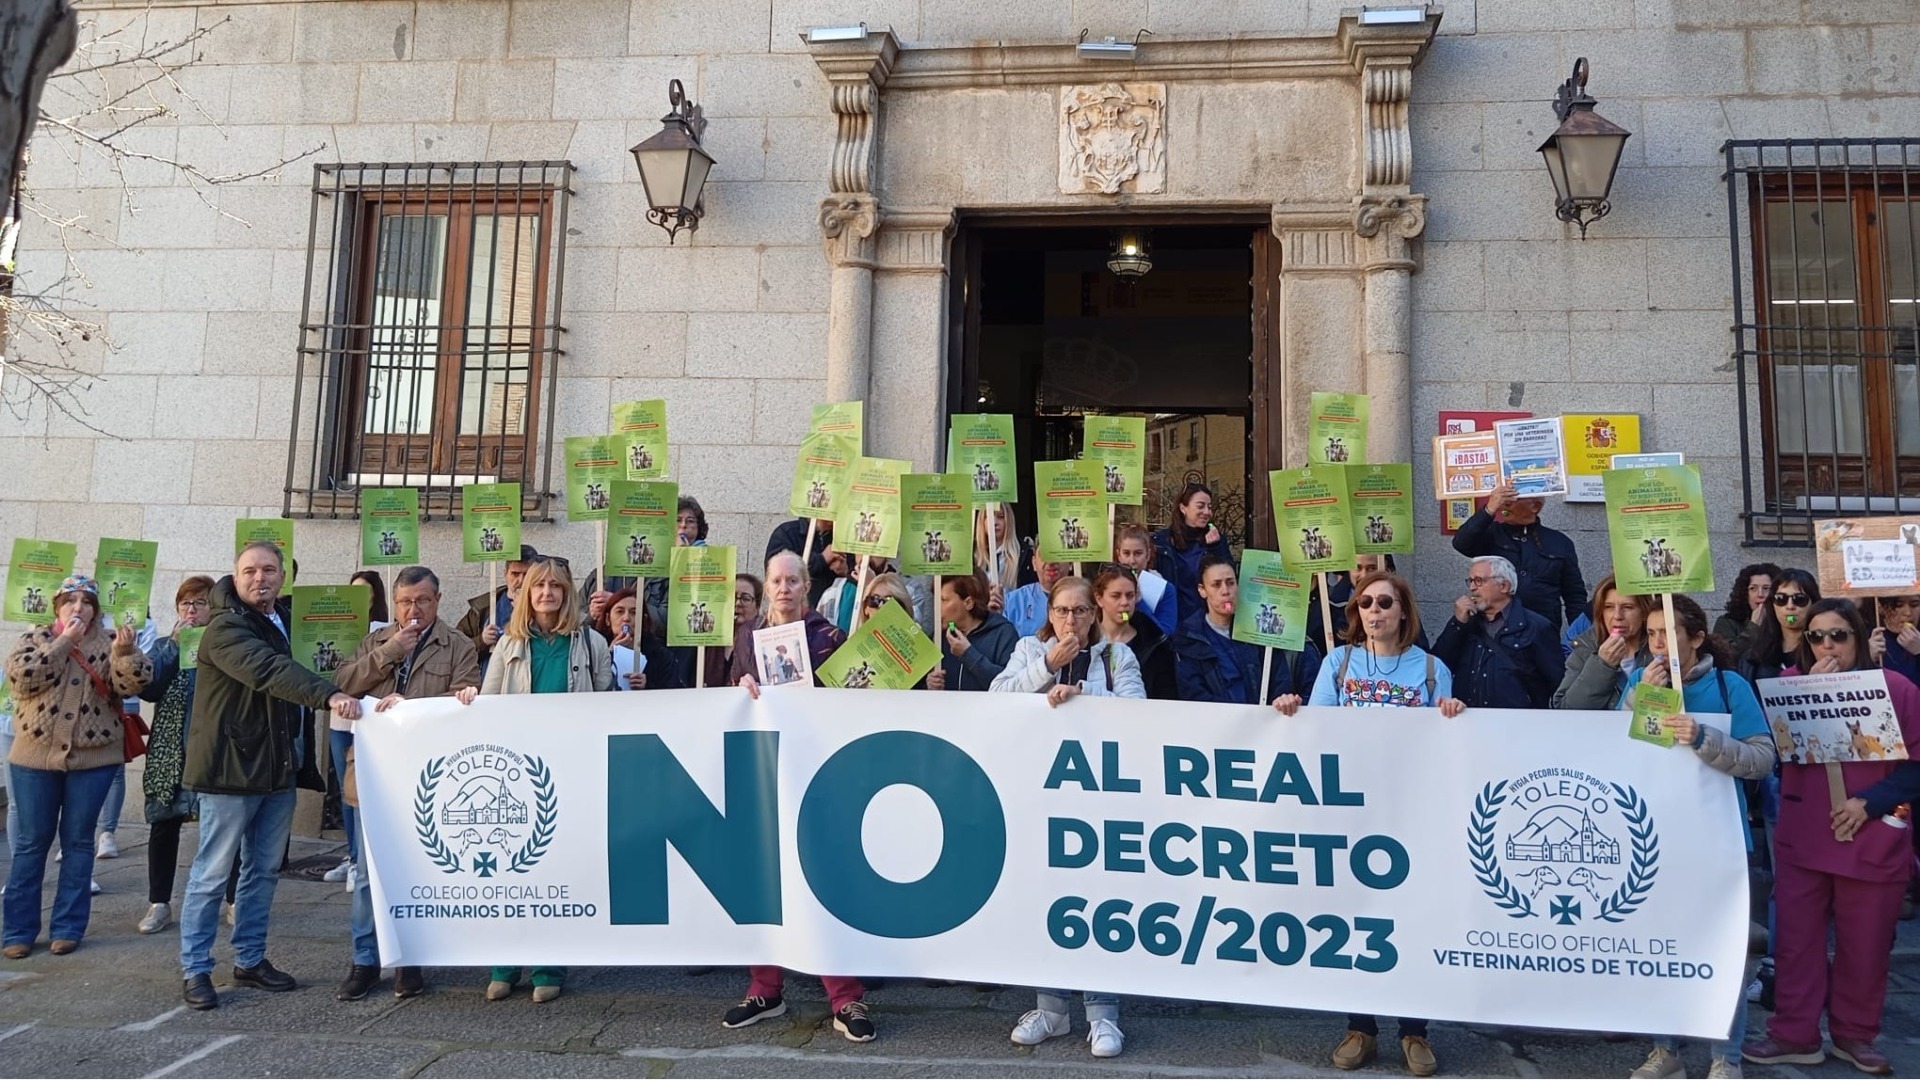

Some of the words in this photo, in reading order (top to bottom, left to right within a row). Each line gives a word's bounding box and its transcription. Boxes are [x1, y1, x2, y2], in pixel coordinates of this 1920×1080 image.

[1454, 452, 1489, 465] ¡BASTA!
[1764, 693, 1834, 708] NUESTRA
[1836, 689, 1886, 703] SALUD
[1787, 710, 1807, 721] EN
[1809, 706, 1871, 720] PELIGRO
[446, 754, 521, 782] TOLEDO
[485, 744, 504, 755] SALUS
[503, 748, 524, 766] POPULI
[1043, 740, 1141, 794] AL
[1162, 745, 1365, 807] REAL
[1508, 776, 1530, 794] HYGIA
[1529, 768, 1560, 783] PECORIS
[1560, 768, 1585, 781] SALUS
[1585, 774, 1612, 796] POPULI
[1511, 780, 1609, 814] TOLEDO
[607, 729, 1007, 940] NO
[1047, 817, 1411, 890] DECRETO
[410, 885, 478, 900] COLEGIO
[482, 885, 543, 900] OFICIAL
[548, 885, 570, 899] DE
[504, 905, 526, 918] DE
[530, 903, 596, 918] TOLEDO
[1047, 896, 1399, 974] 666/2023
[1466, 930, 1557, 950] COLEGIO
[1562, 936, 1643, 955] OFICIAL
[1649, 939, 1678, 955] DE
[1433, 949, 1585, 974] VETERINARIOS
[1592, 959, 1620, 975] DE
[1626, 960, 1713, 980] TOLEDO
